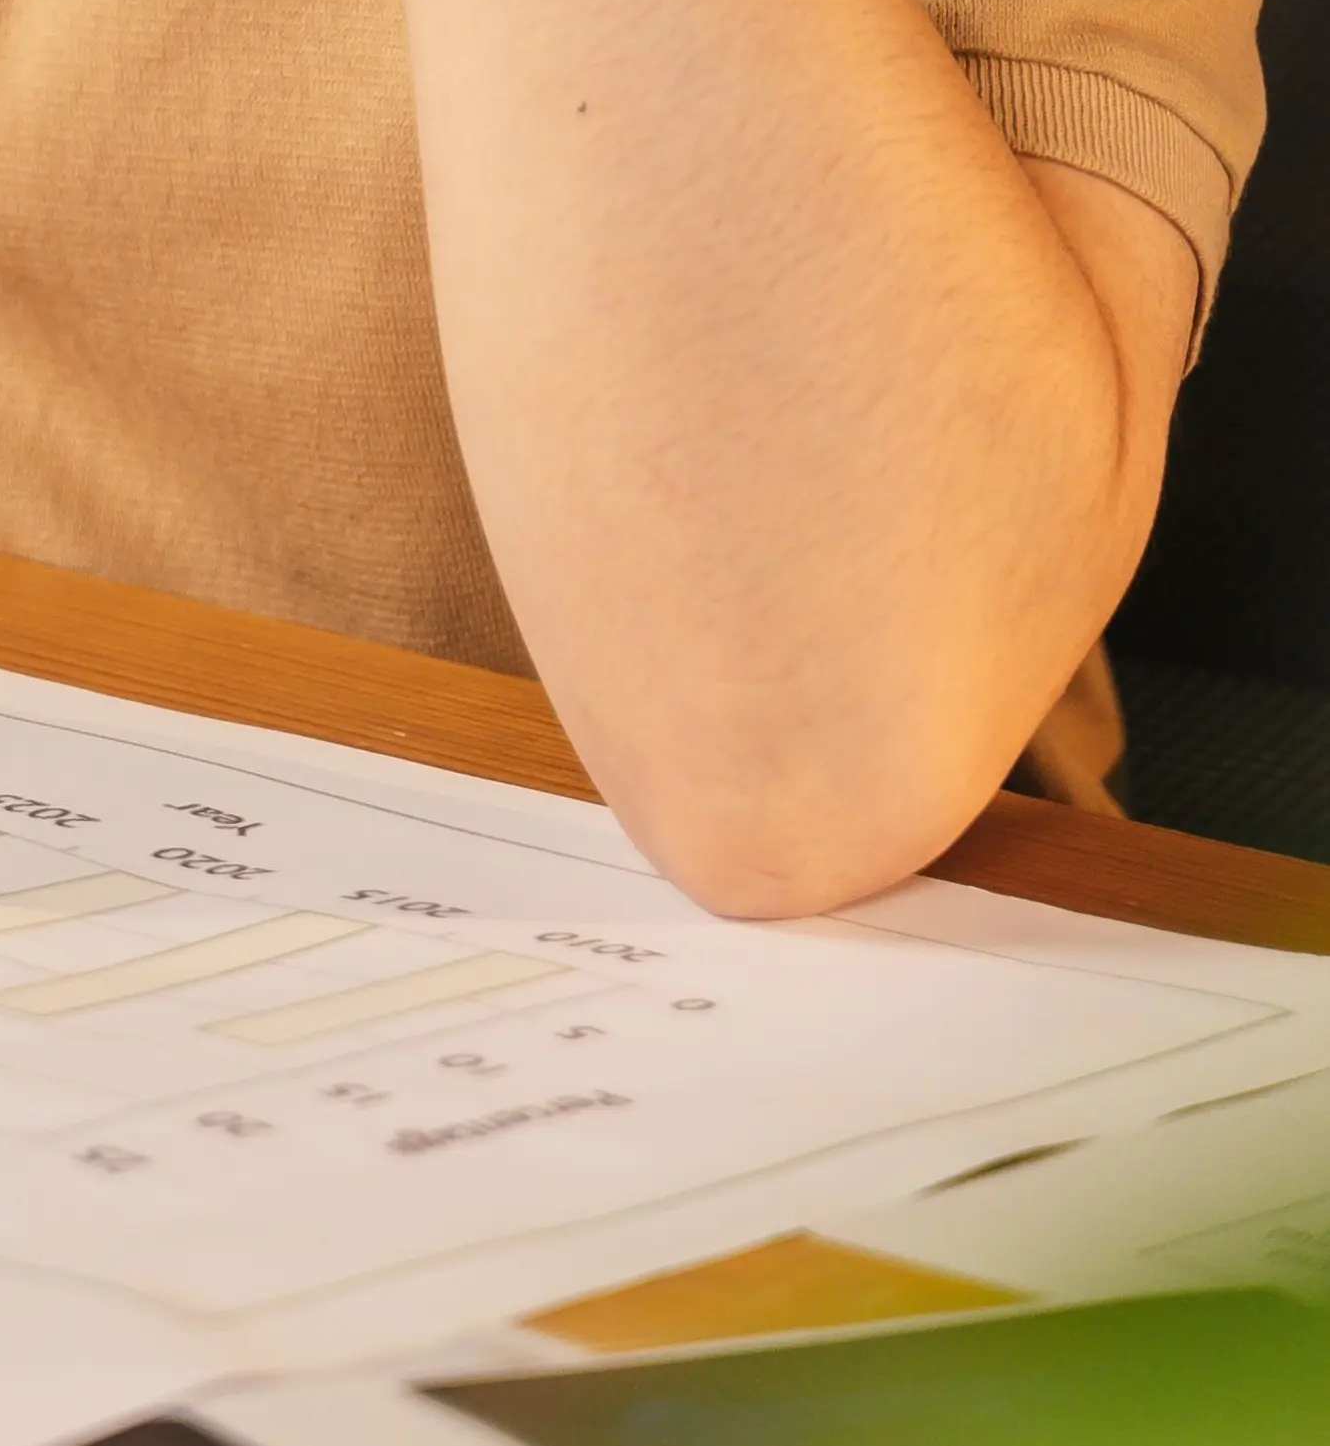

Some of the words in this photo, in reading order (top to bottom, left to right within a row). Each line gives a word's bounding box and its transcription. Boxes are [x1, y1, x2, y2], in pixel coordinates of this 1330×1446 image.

[163, 797, 266, 838] Year
[150, 843, 278, 881] 2020
[339, 887, 473, 920] 2015
[533, 928, 667, 965] 2010
[669, 995, 716, 1012] 0
[555, 1022, 606, 1042] 5
[436, 1052, 508, 1077] 10
